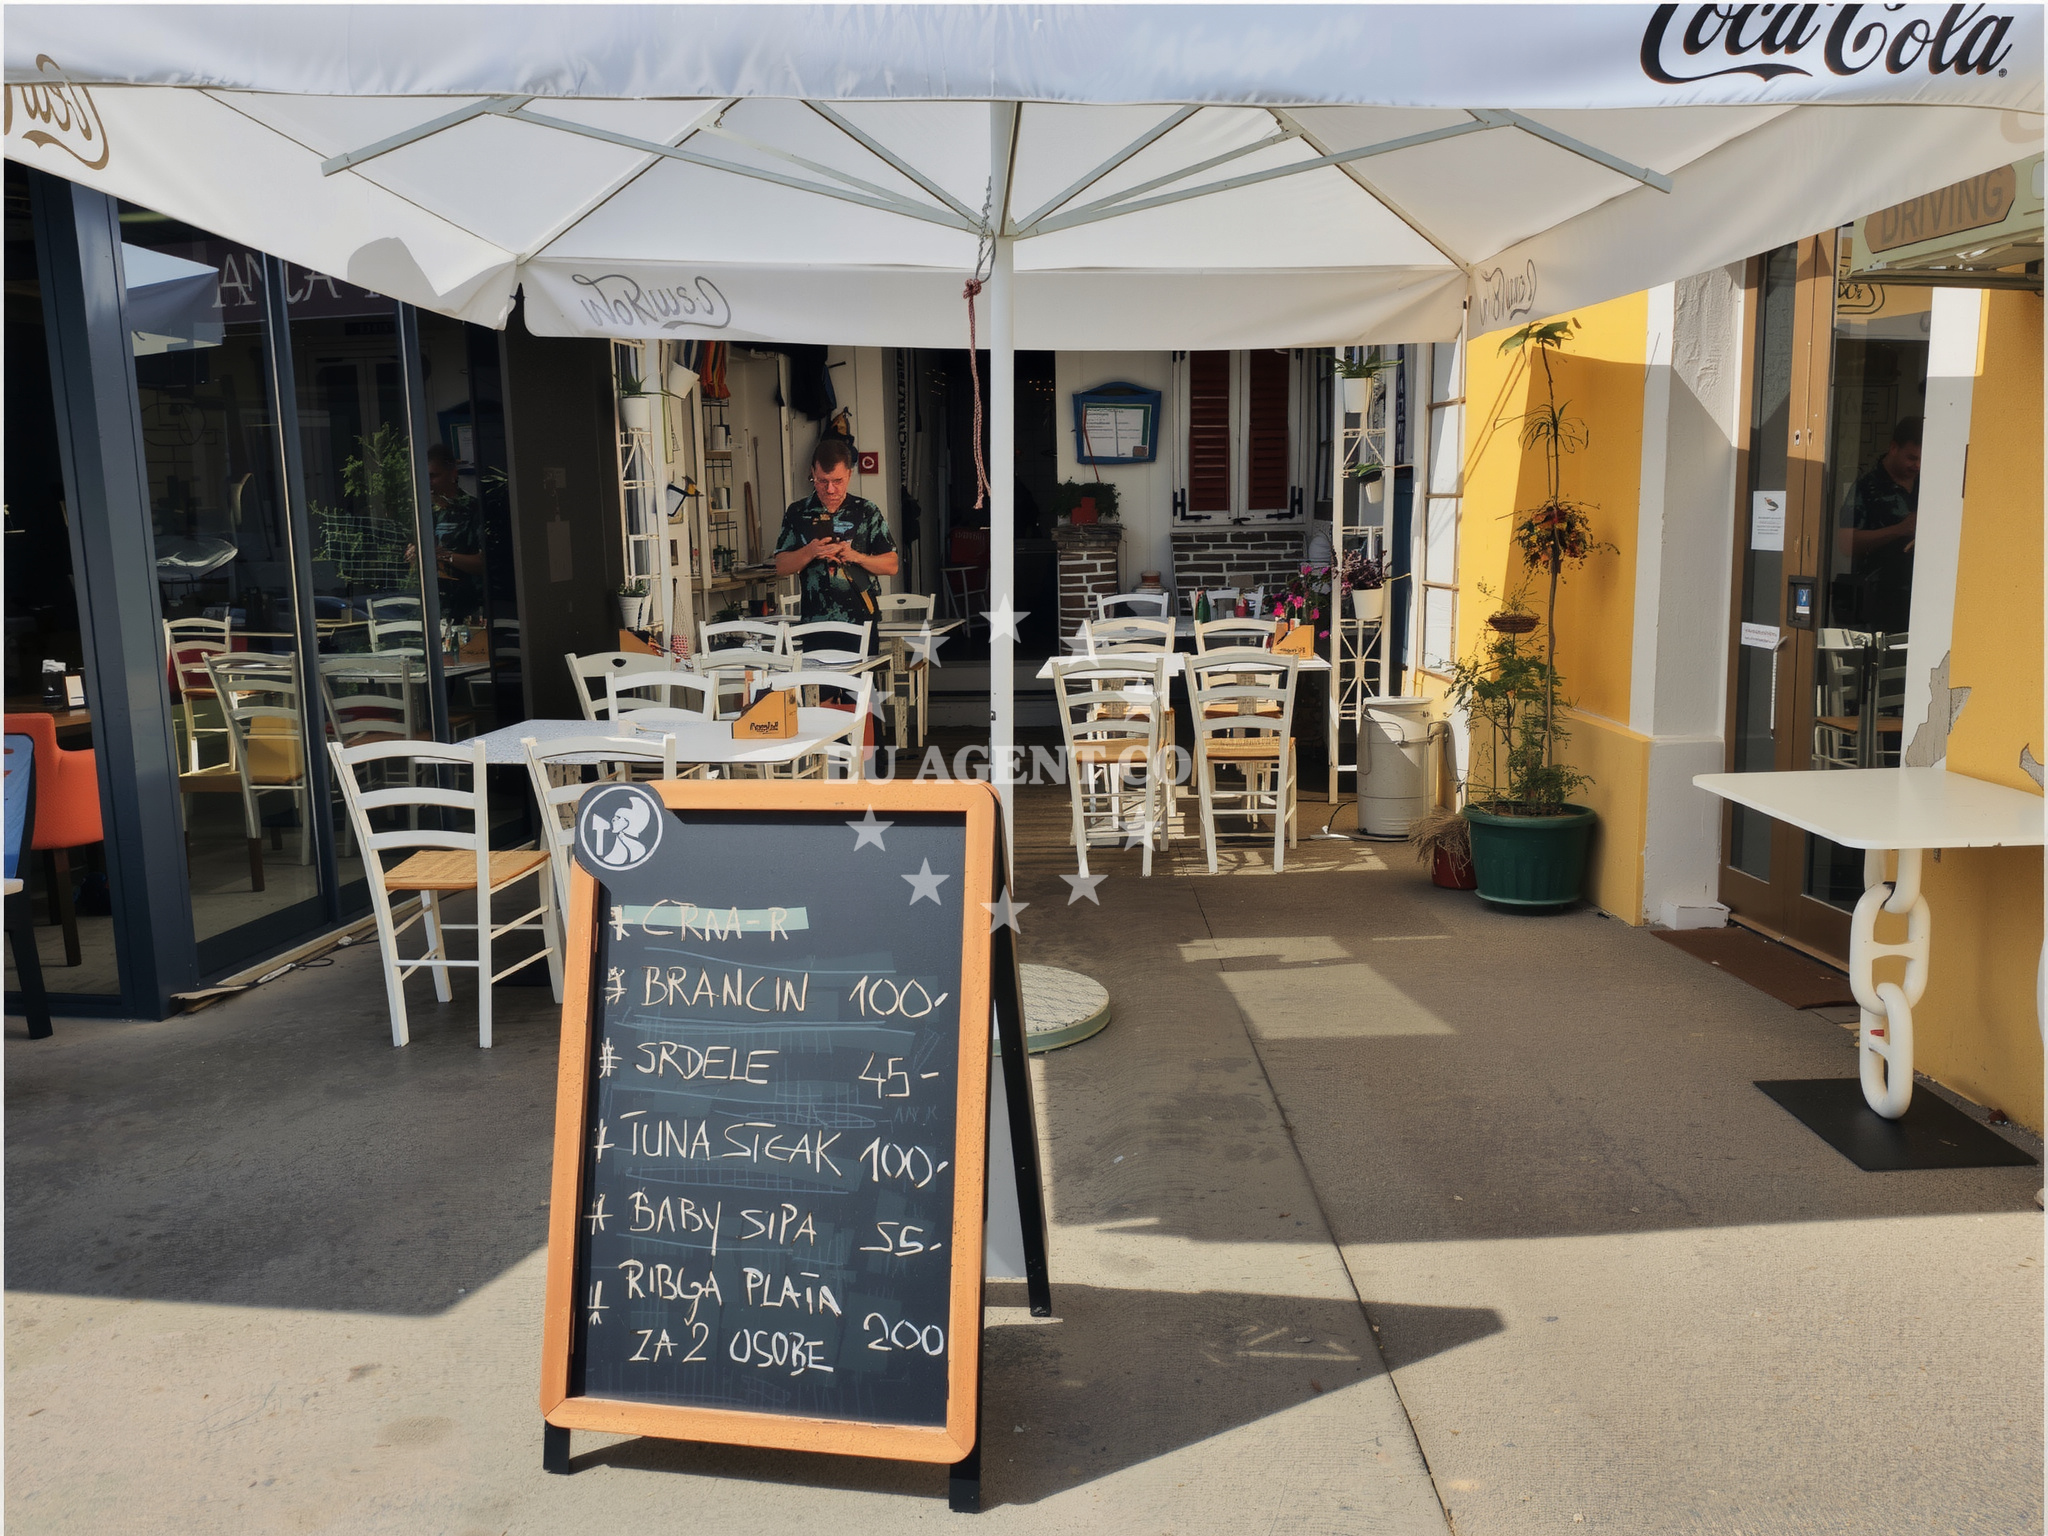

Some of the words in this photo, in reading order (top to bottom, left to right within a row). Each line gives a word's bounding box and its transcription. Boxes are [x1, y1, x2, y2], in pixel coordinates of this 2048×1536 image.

[1880, 168, 2005, 246] DRIVING
[641, 966, 809, 1012] BRANCIN
[634, 1041, 779, 1084] SRDELE
[619, 1110, 711, 1161] TUNA
[722, 1122, 843, 1178] STEAK
[628, 1188, 722, 1256] BABY
[736, 1203, 818, 1246] SIPA
[629, 1328, 678, 1362] ZA
[682, 1322, 709, 1363] 2
[729, 1328, 834, 1376] OSOBE
[863, 1312, 944, 1356] 200
